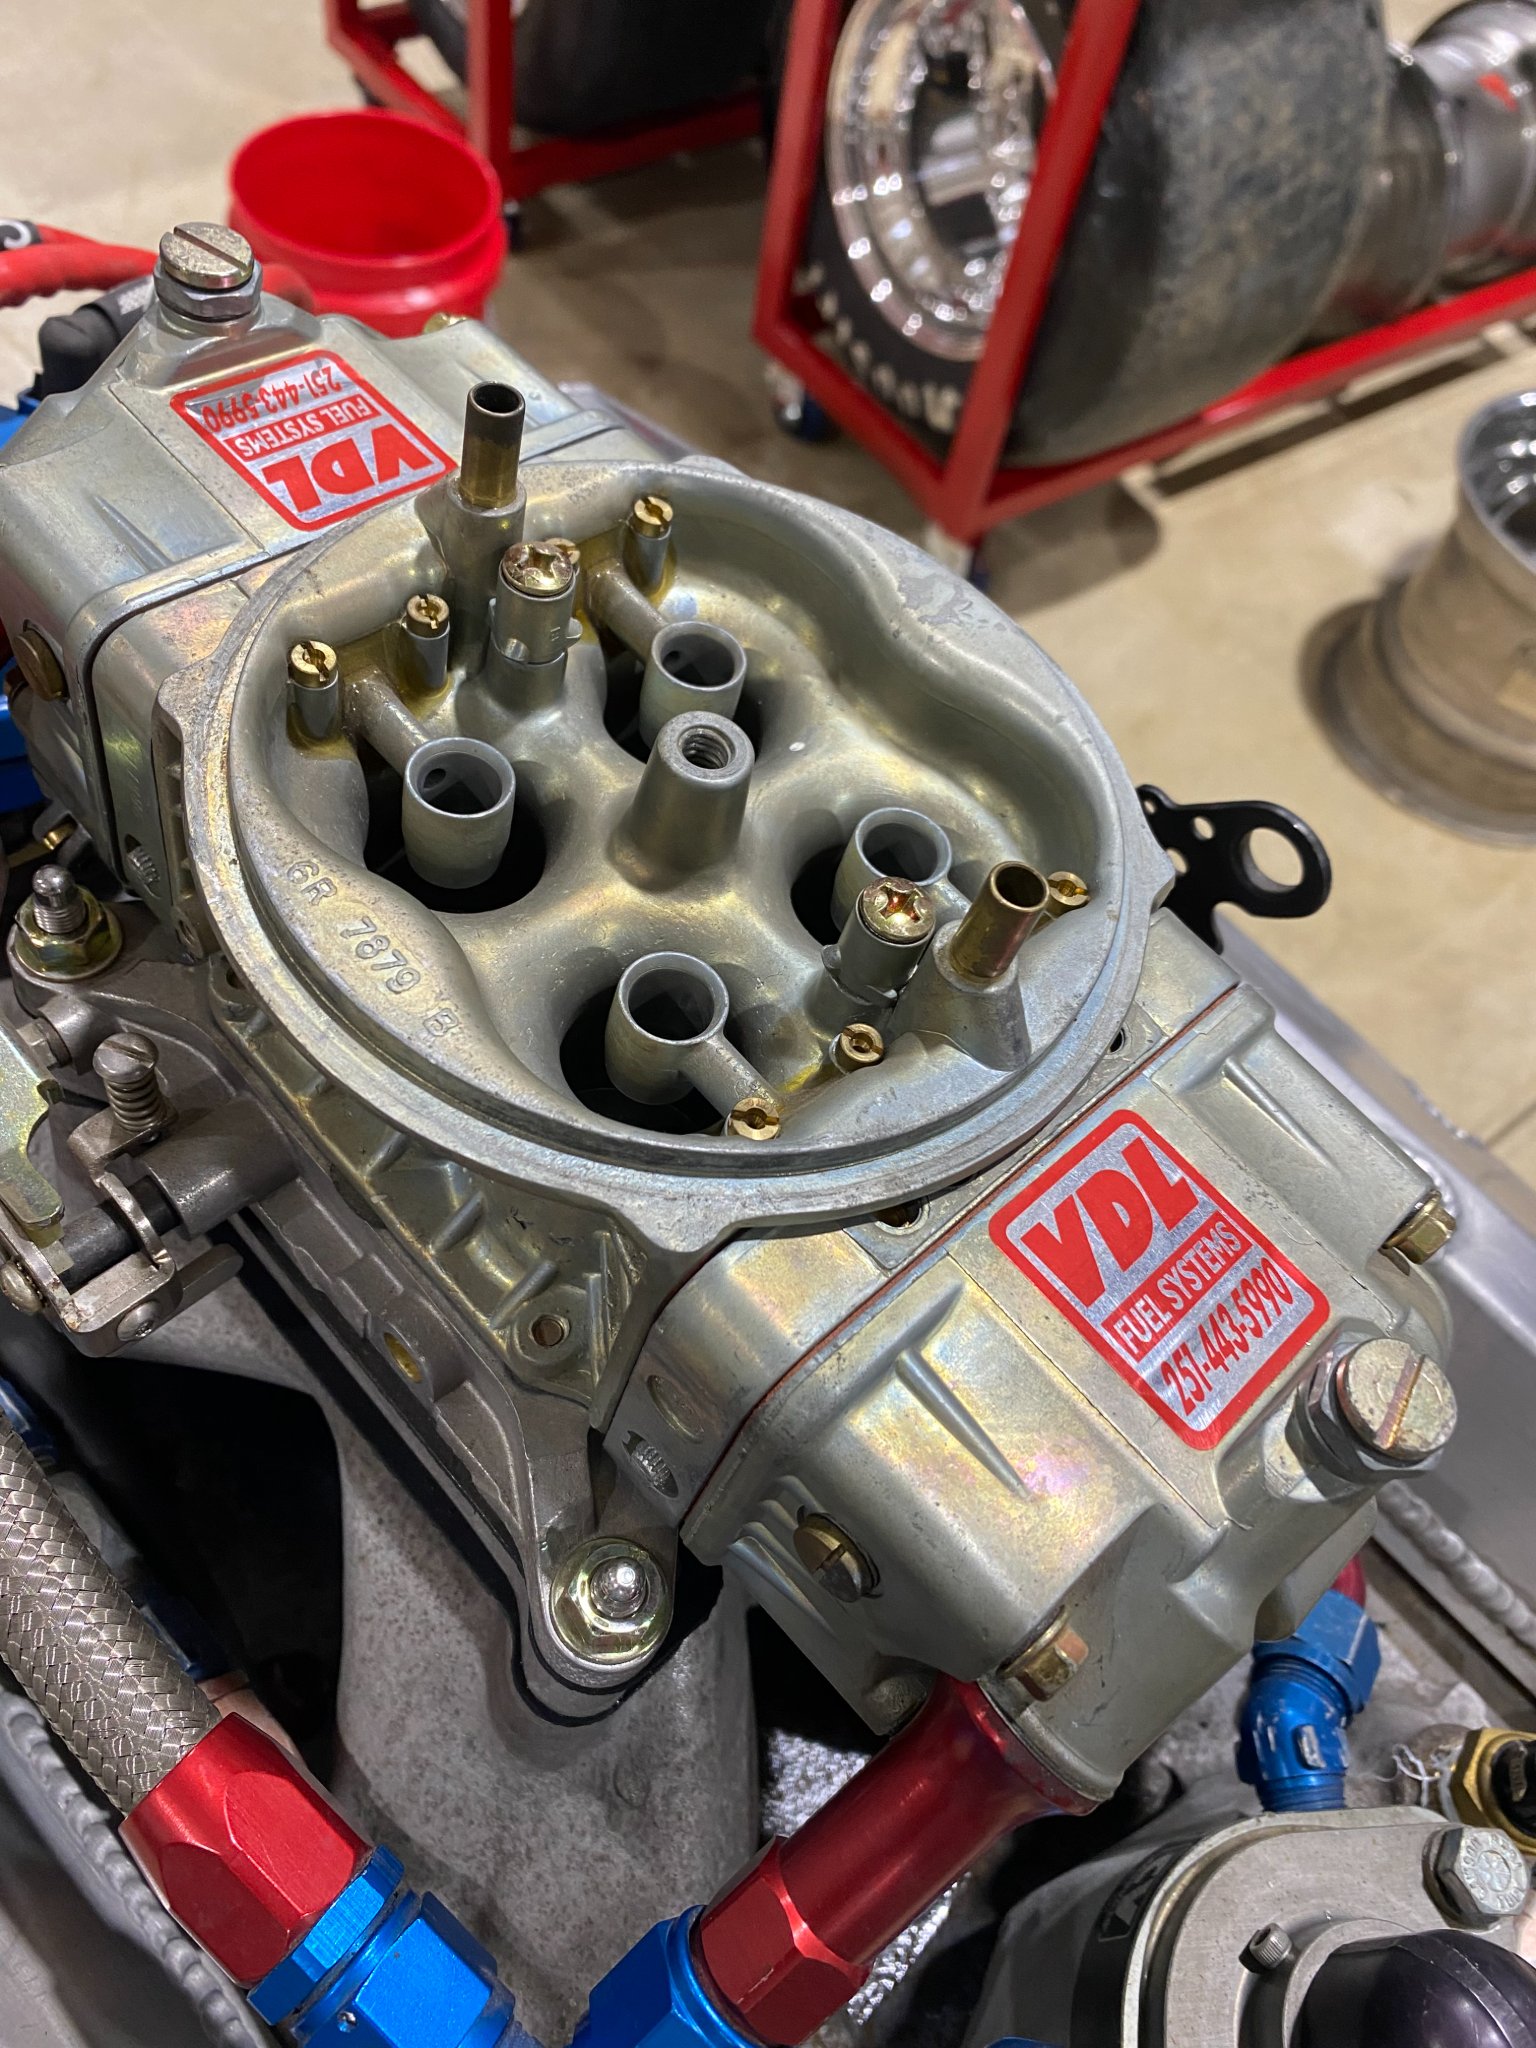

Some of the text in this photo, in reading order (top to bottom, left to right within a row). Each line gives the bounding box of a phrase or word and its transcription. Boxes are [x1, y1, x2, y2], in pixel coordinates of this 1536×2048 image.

[202, 366, 342, 432] 251-443-5990
[234, 396, 375, 457] FUEL SYSTEMS
[261, 423, 435, 513] VDL
[340, 915, 421, 995] 7879
[1019, 1136, 1200, 1309] VDL
[1112, 1220, 1242, 1355] FUEL SYSTEMS
[1160, 1257, 1294, 1416] 251-443-5990
